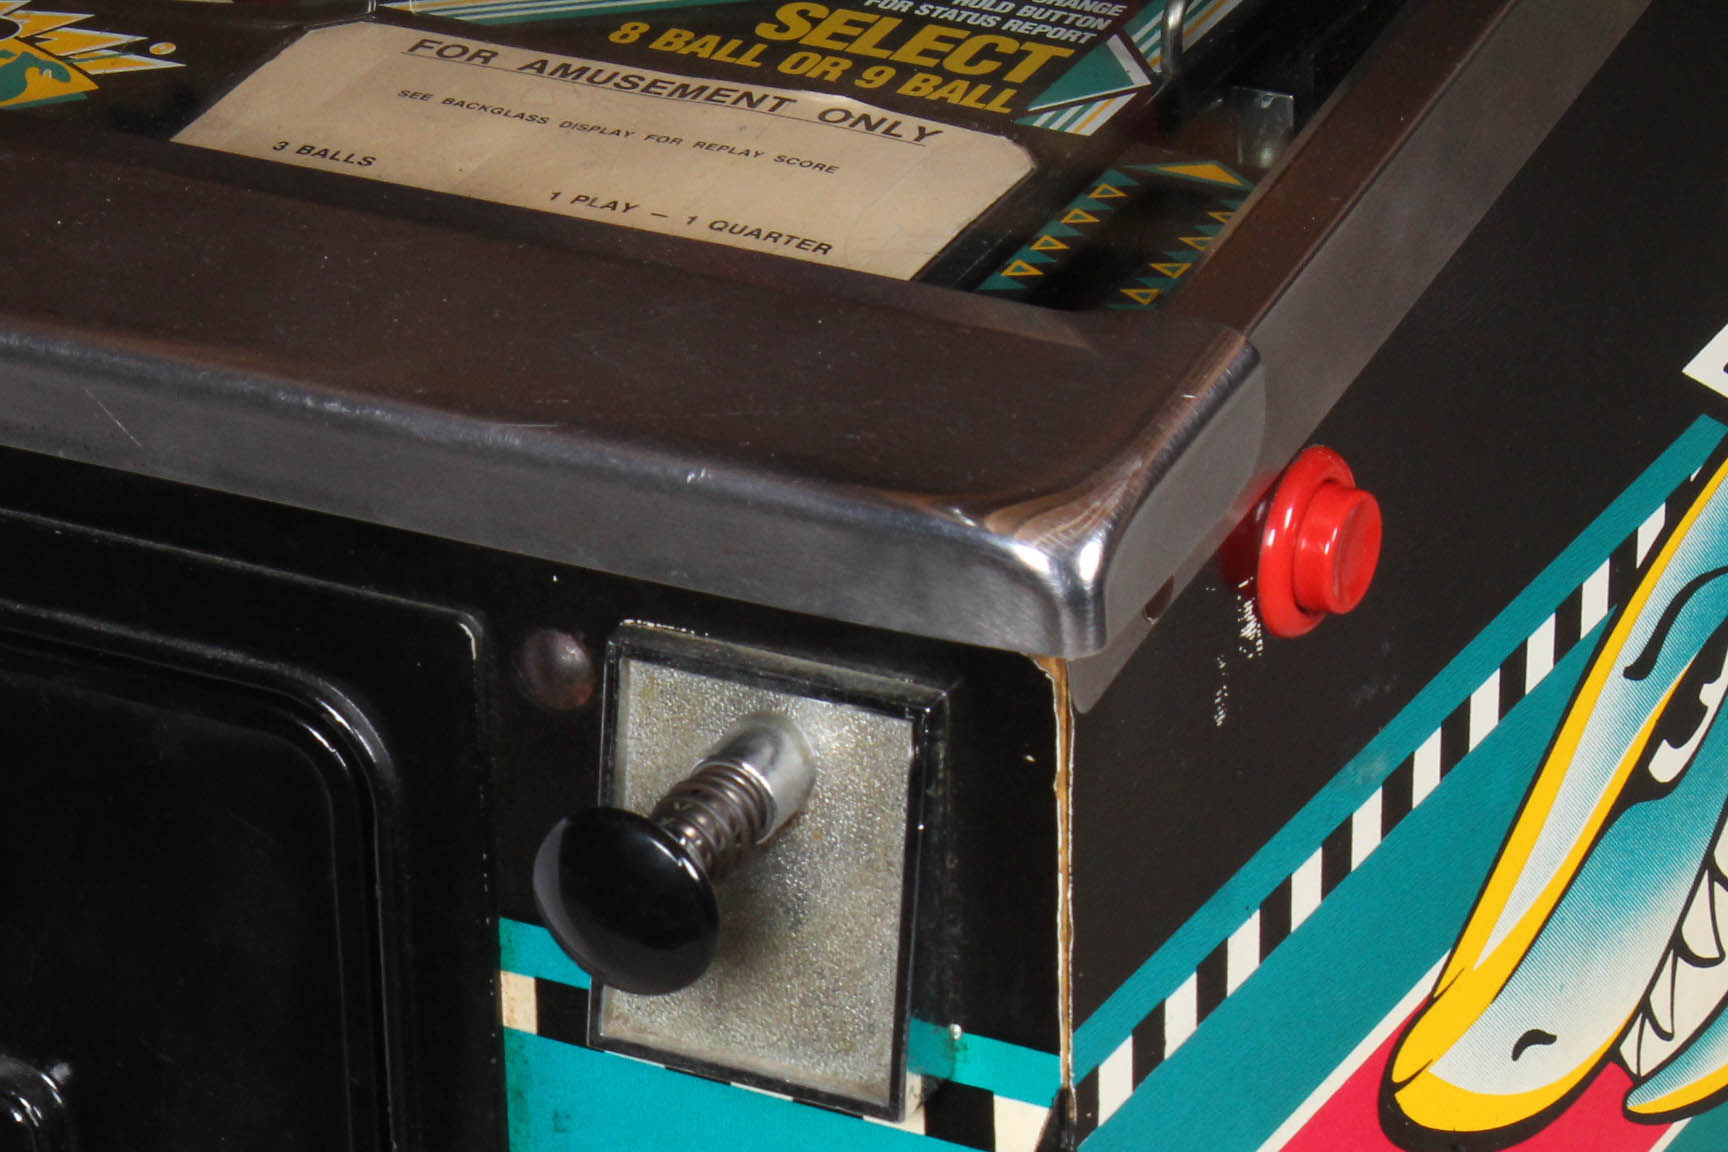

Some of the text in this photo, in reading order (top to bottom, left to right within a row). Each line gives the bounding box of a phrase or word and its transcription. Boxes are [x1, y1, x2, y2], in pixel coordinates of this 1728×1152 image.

[914, 3, 999, 28] STATUS
[1001, 18, 1098, 45] REPORT
[1016, 4, 1112, 31] BUTTON
[1030, 0, 1128, 17] HANGE
[608, 22, 1019, 114] 8 BALL OR 9 BALL
[754, 1, 1075, 84] SELECT
[406, 38, 944, 143] FOR AMUSEMENT ONLY
[272, 140, 377, 168] 3 BALLS
[396, 89, 841, 175] SEE BACKGLASS DISPLAY FOR REPLAY SCORE
[549, 191, 562, 201] 1
[569, 194, 640, 214] PLAY
[685, 215, 699, 226] 1
[707, 219, 834, 256] QUARTER
